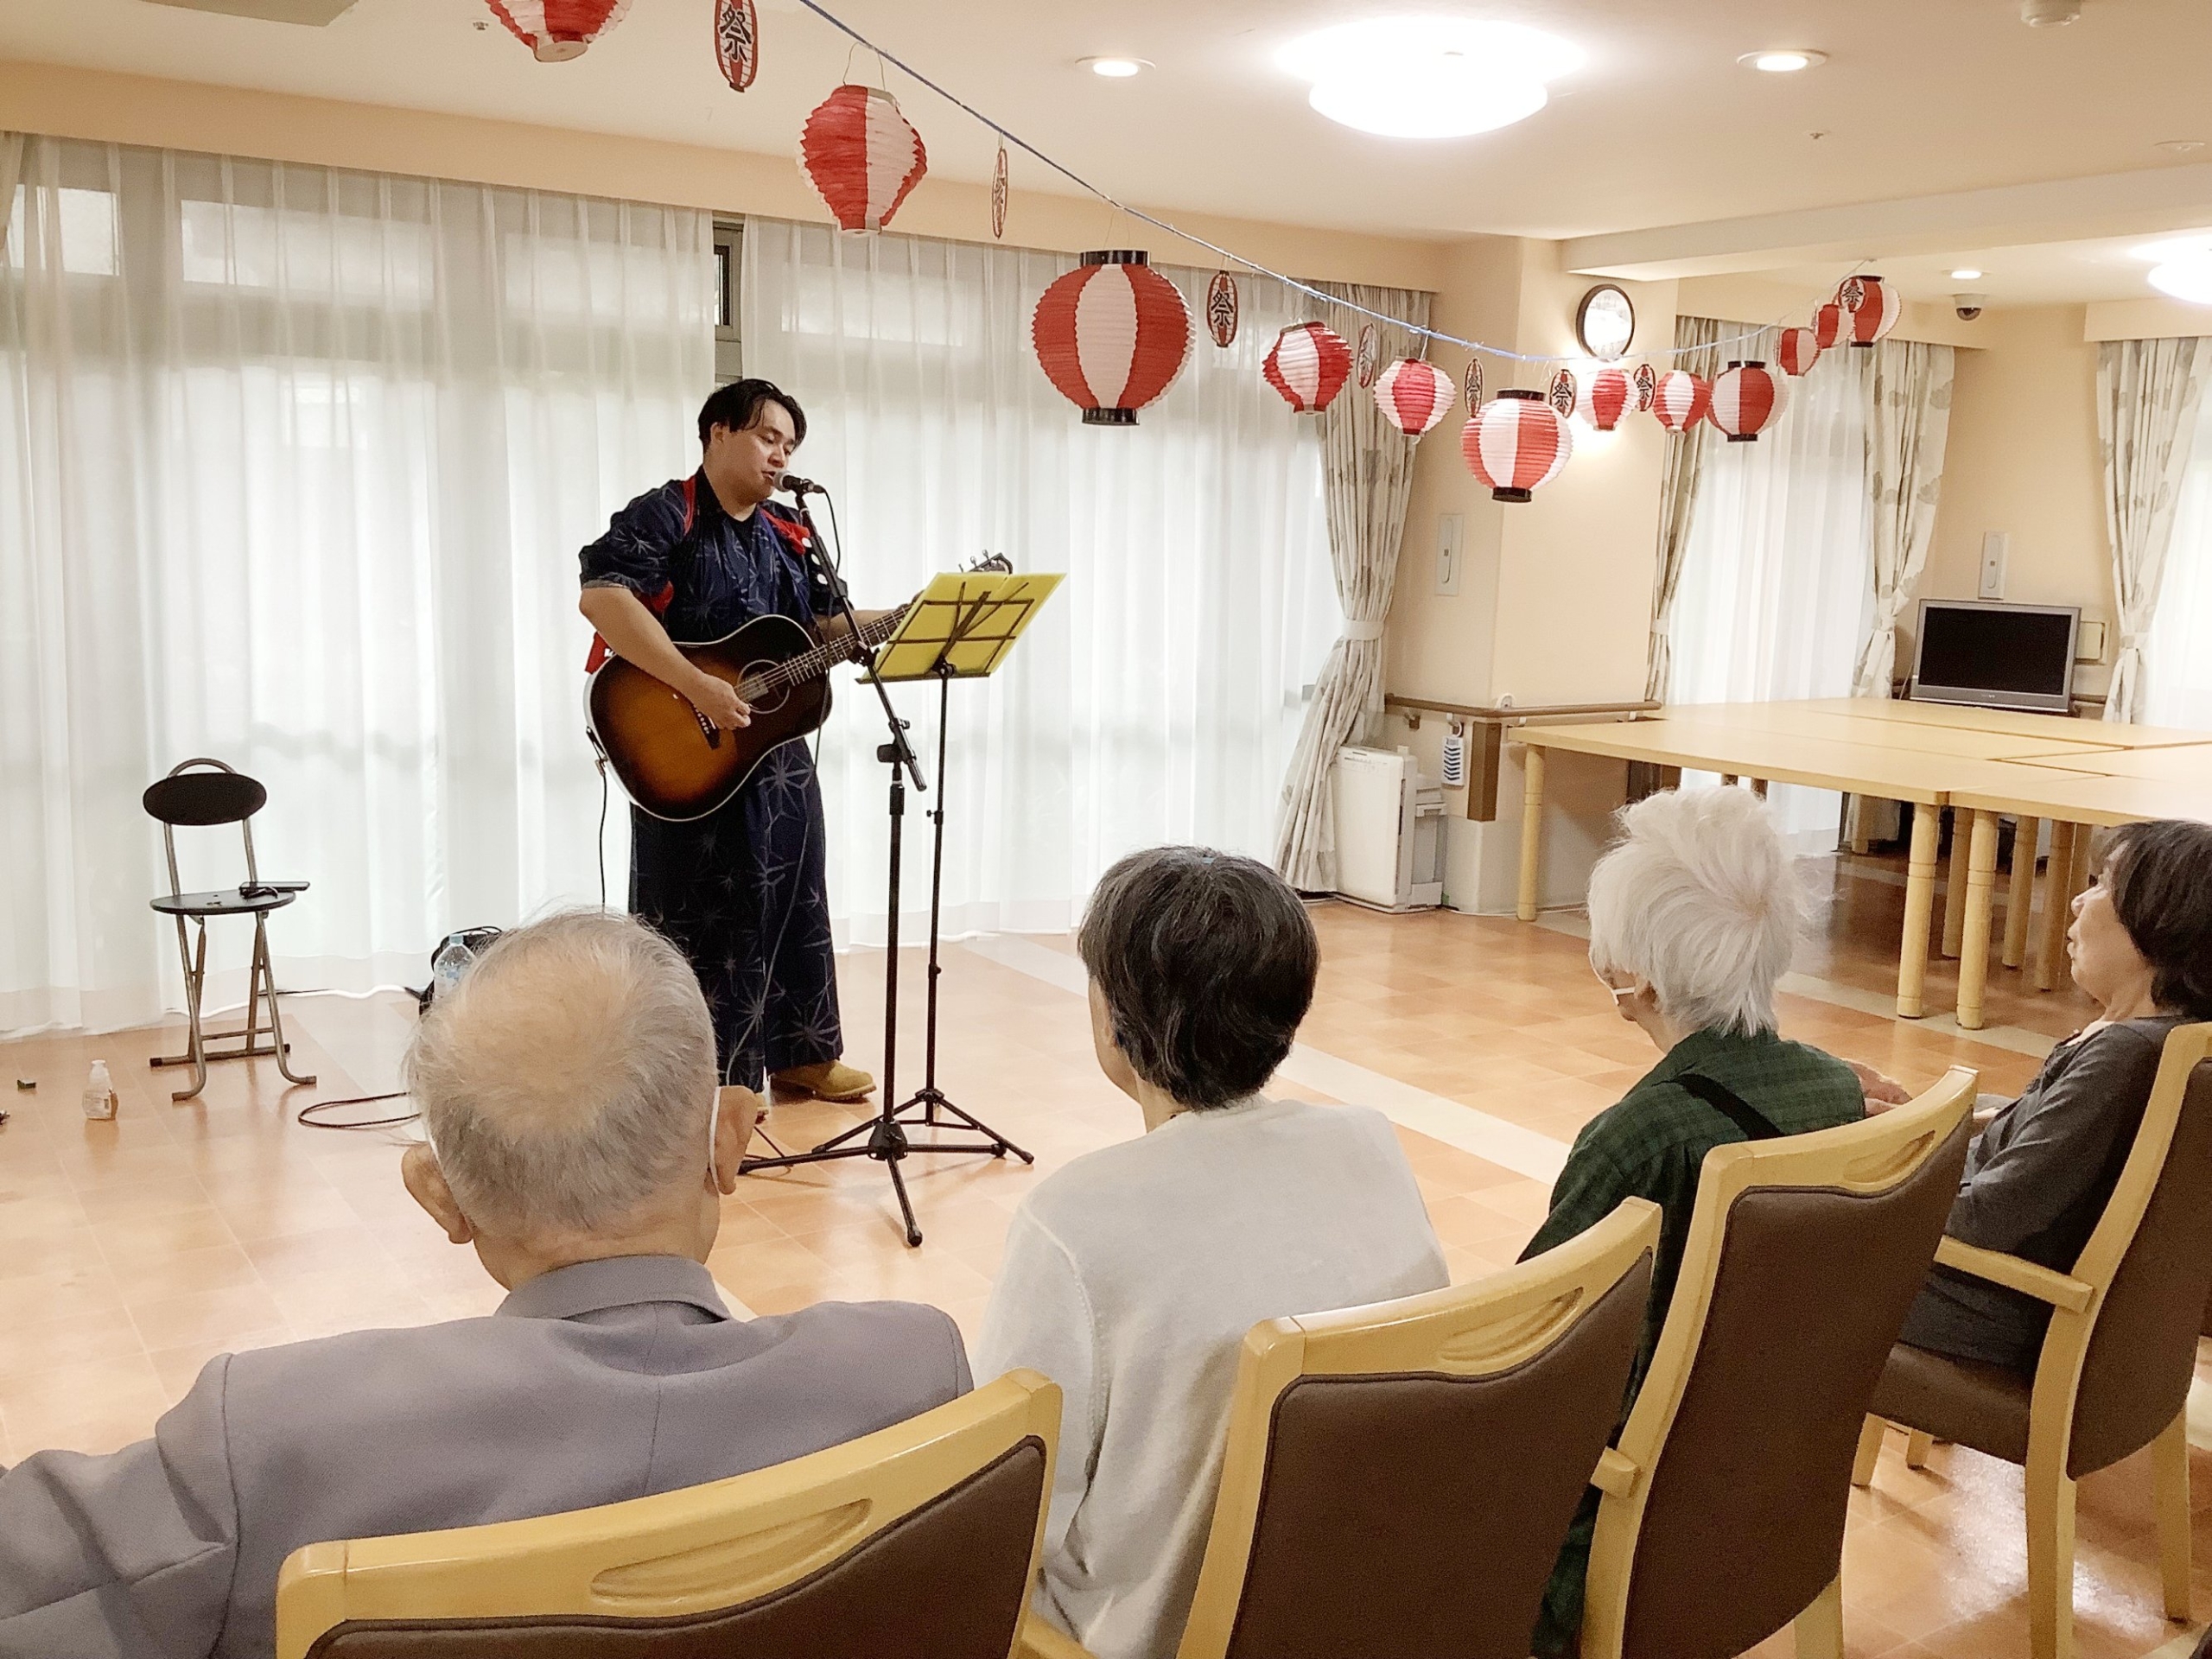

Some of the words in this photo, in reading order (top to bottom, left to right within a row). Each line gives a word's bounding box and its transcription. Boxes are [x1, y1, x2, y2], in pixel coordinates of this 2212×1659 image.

[720, 3, 752, 62] 祭
[1211, 289, 1234, 327] 祭
[1841, 286, 1863, 303] 祭
[1467, 374, 1480, 402] 祭
[1552, 381, 1572, 407] 祭
[1637, 377, 1652, 399] 祭
